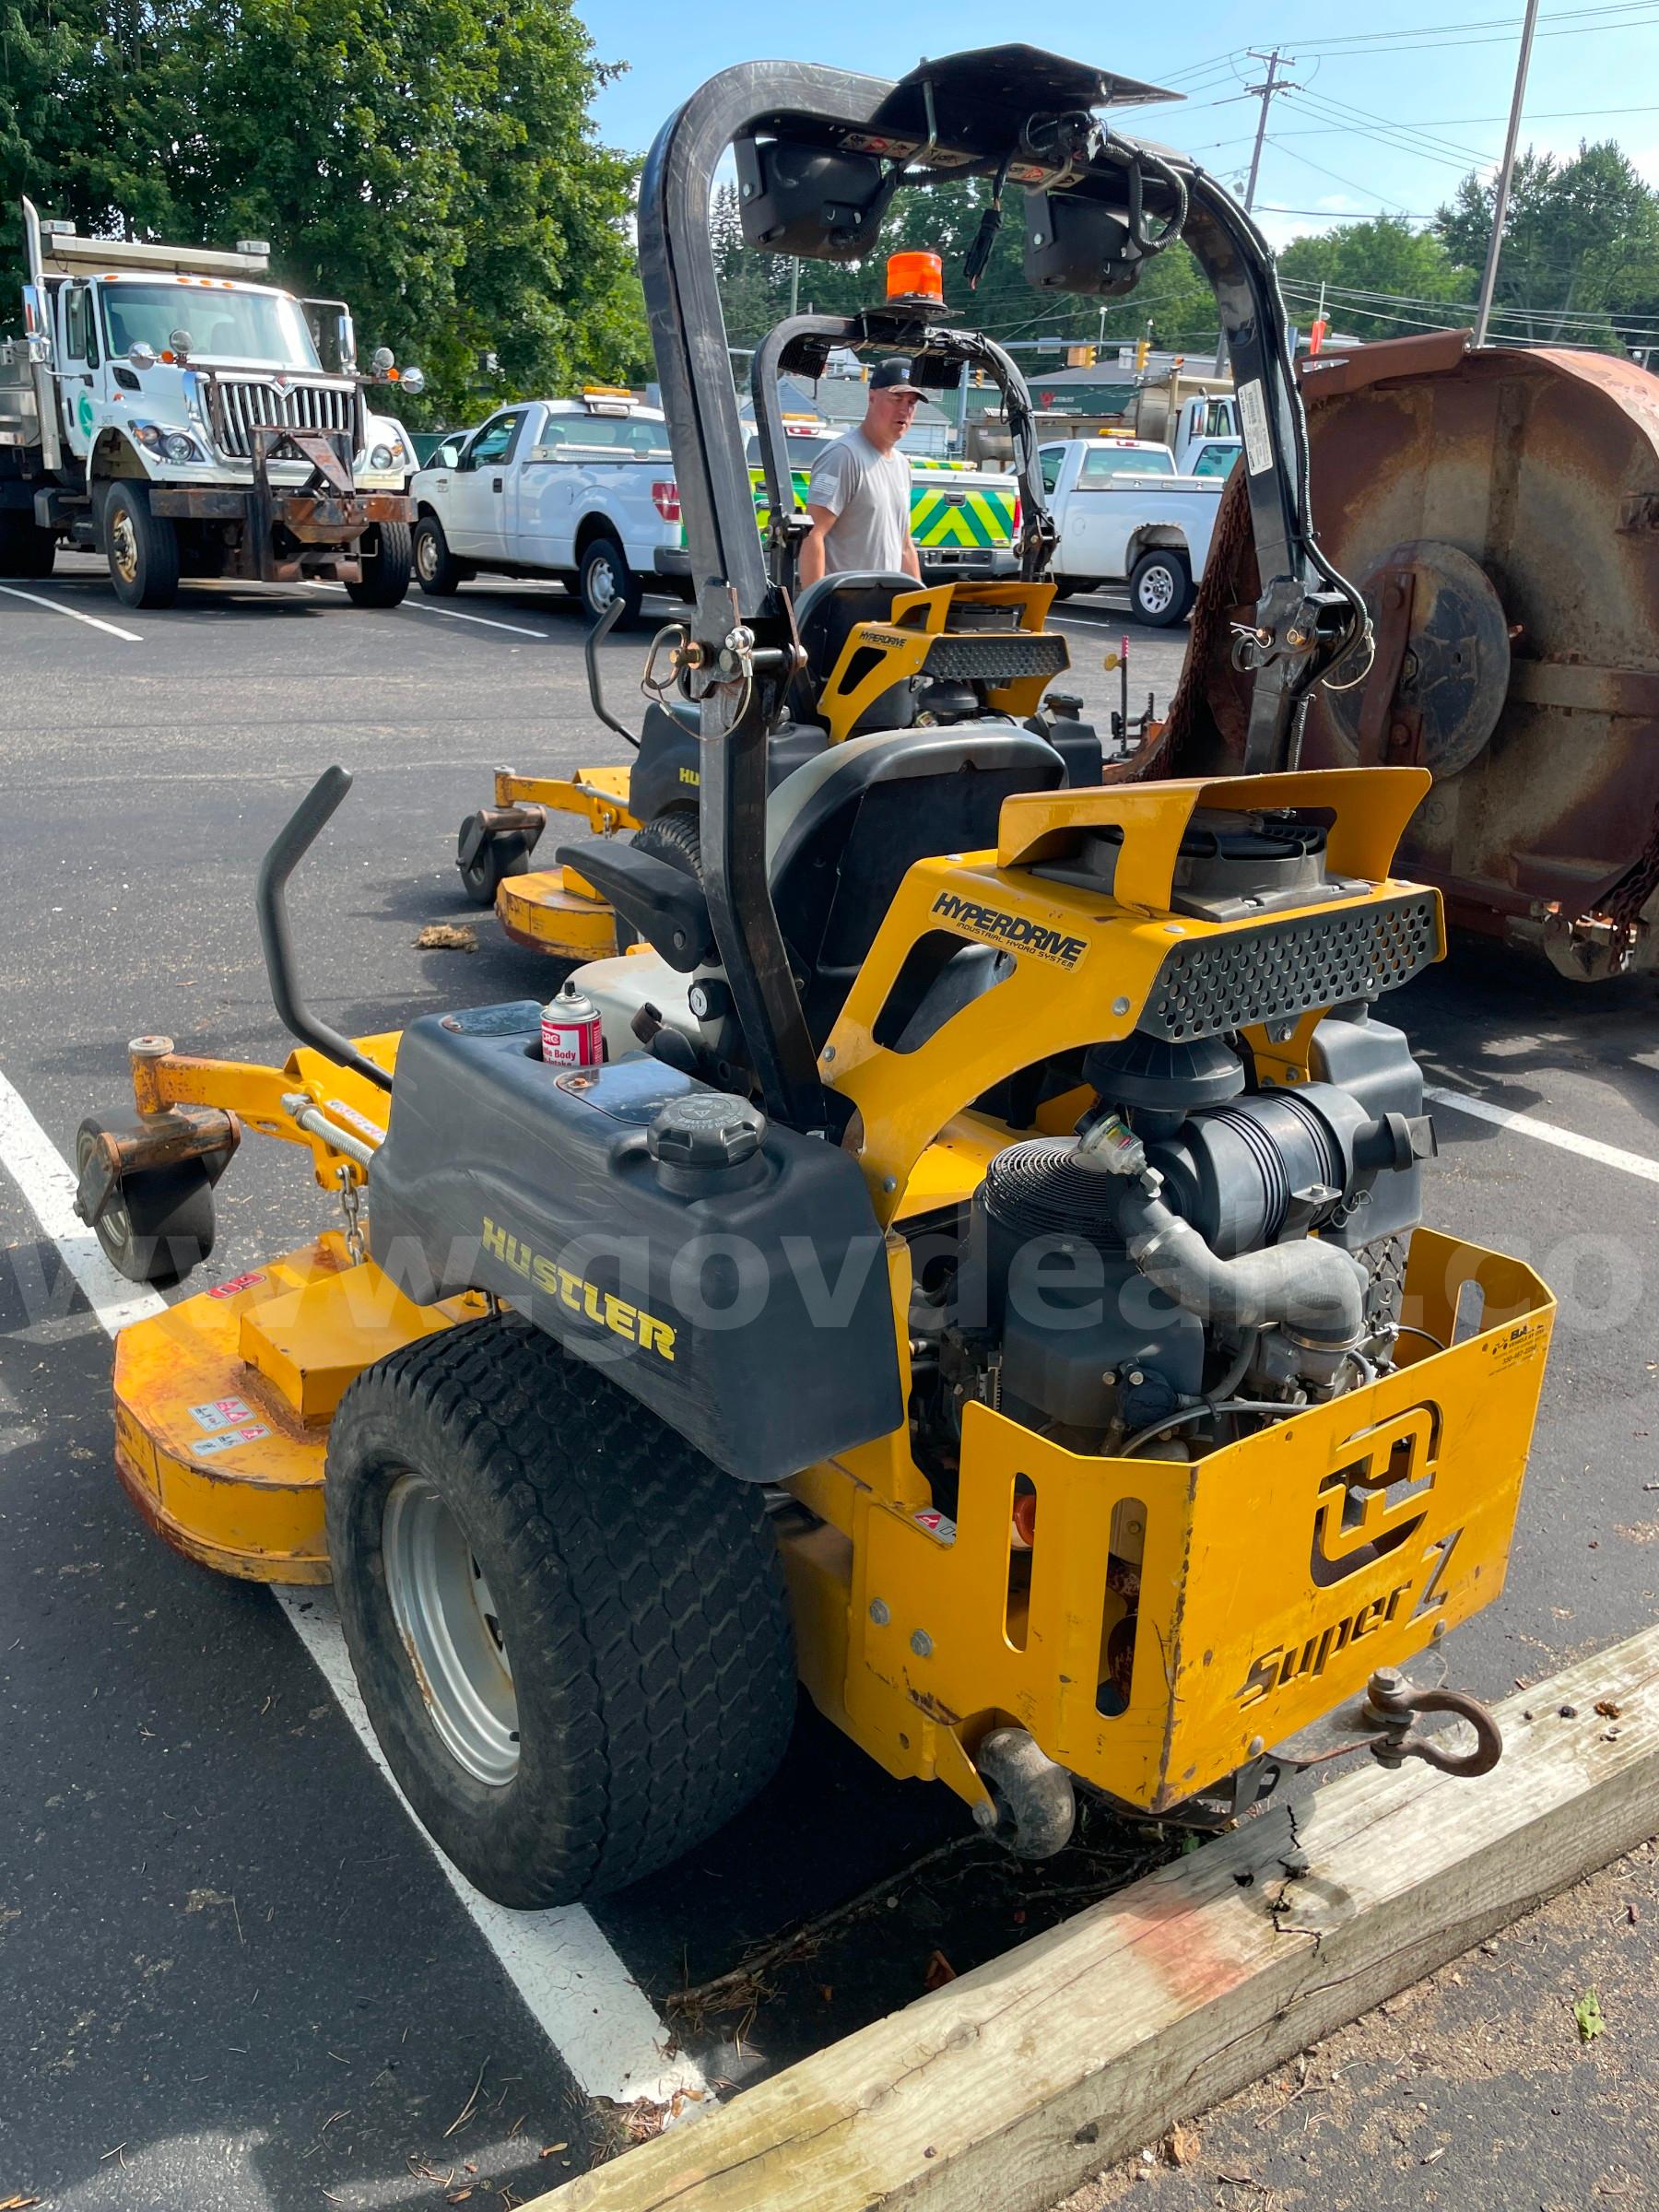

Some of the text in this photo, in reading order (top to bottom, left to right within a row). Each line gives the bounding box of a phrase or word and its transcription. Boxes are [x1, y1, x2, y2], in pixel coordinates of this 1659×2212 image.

[859, 630, 907, 649] HYPERDRIVE
[932, 892, 1087, 962] HYPERDRIVE
[957, 922, 1075, 969] INDUSTRIAL HYDRO SYSTEM
[554, 1049, 576, 1062] Body
[482, 1217, 676, 1360] HUSTLER
[1234, 1526, 1465, 1713] Super Z
